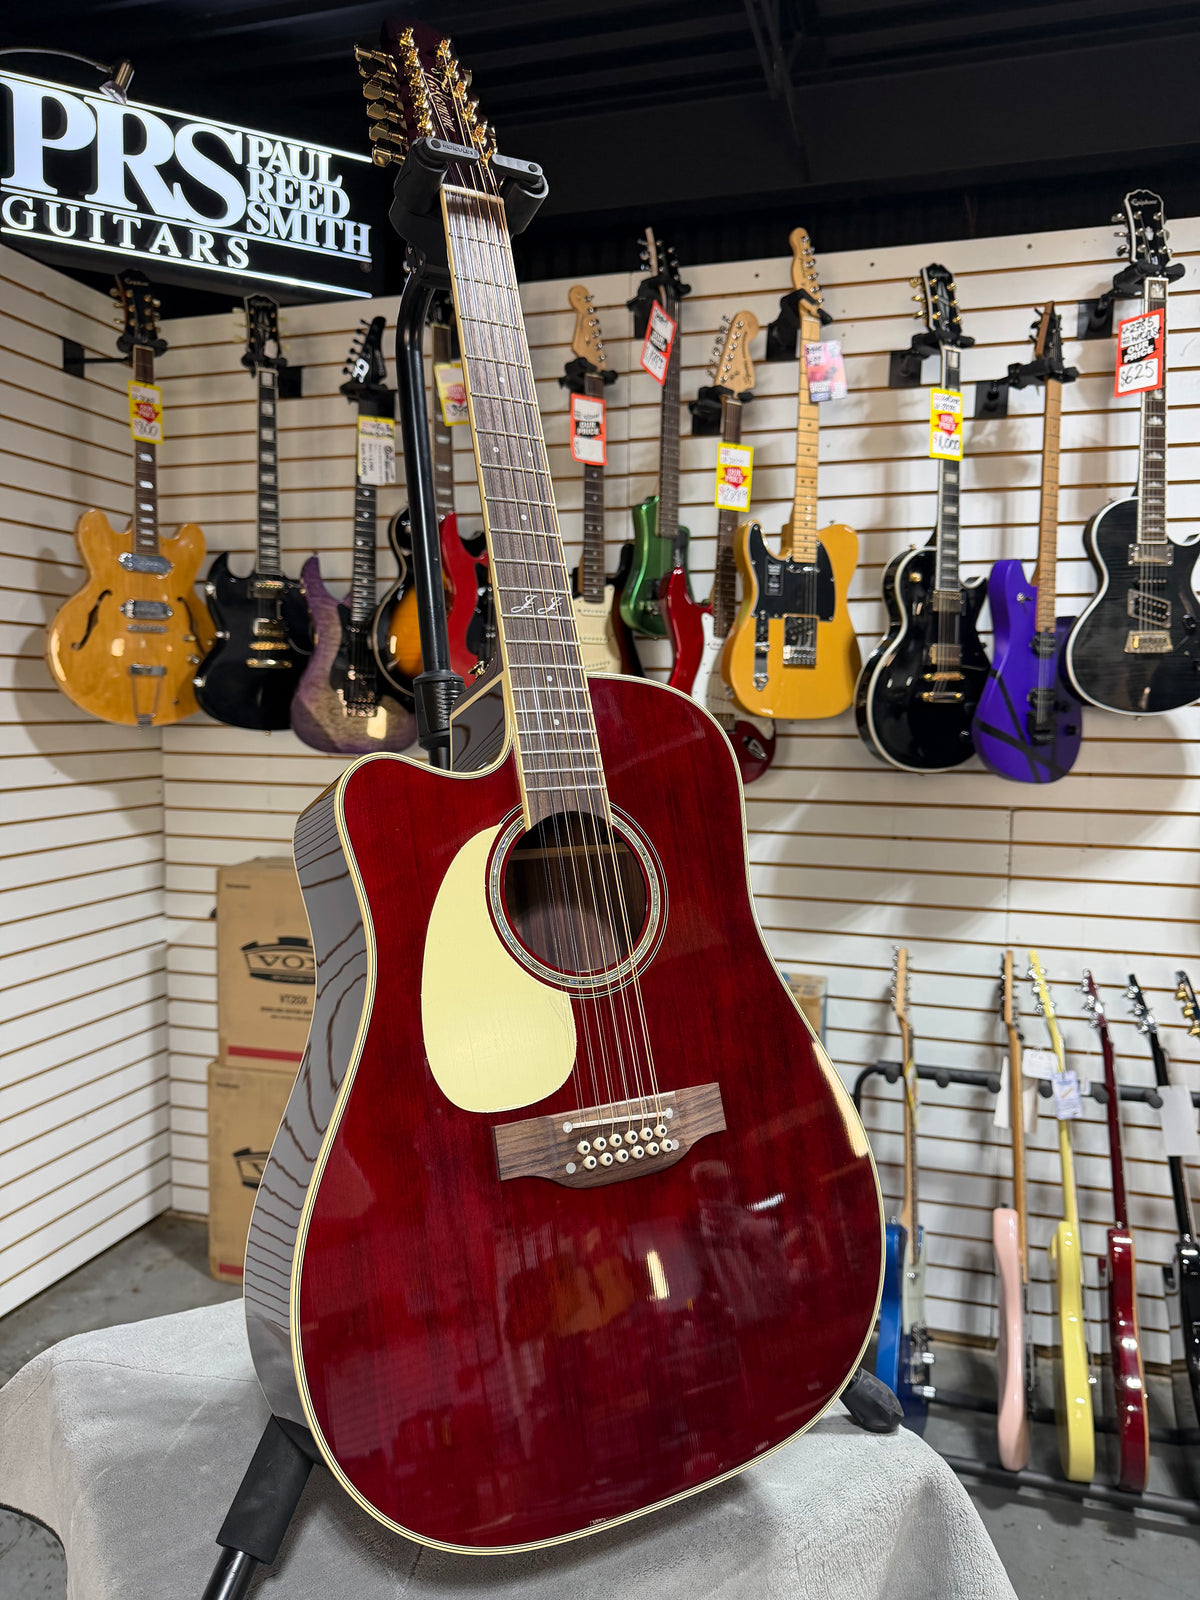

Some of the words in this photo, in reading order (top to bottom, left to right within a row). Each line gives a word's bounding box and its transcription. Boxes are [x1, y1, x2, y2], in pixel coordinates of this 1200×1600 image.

[0, 82, 248, 228] PRS
[246, 133, 343, 188] PAUL
[246, 167, 350, 219] REED
[1, 194, 250, 270] GUITARS
[246, 201, 373, 257] SMITH
[1123, 345, 1155, 364] PRICE
[1127, 340, 1149, 355] OUR
